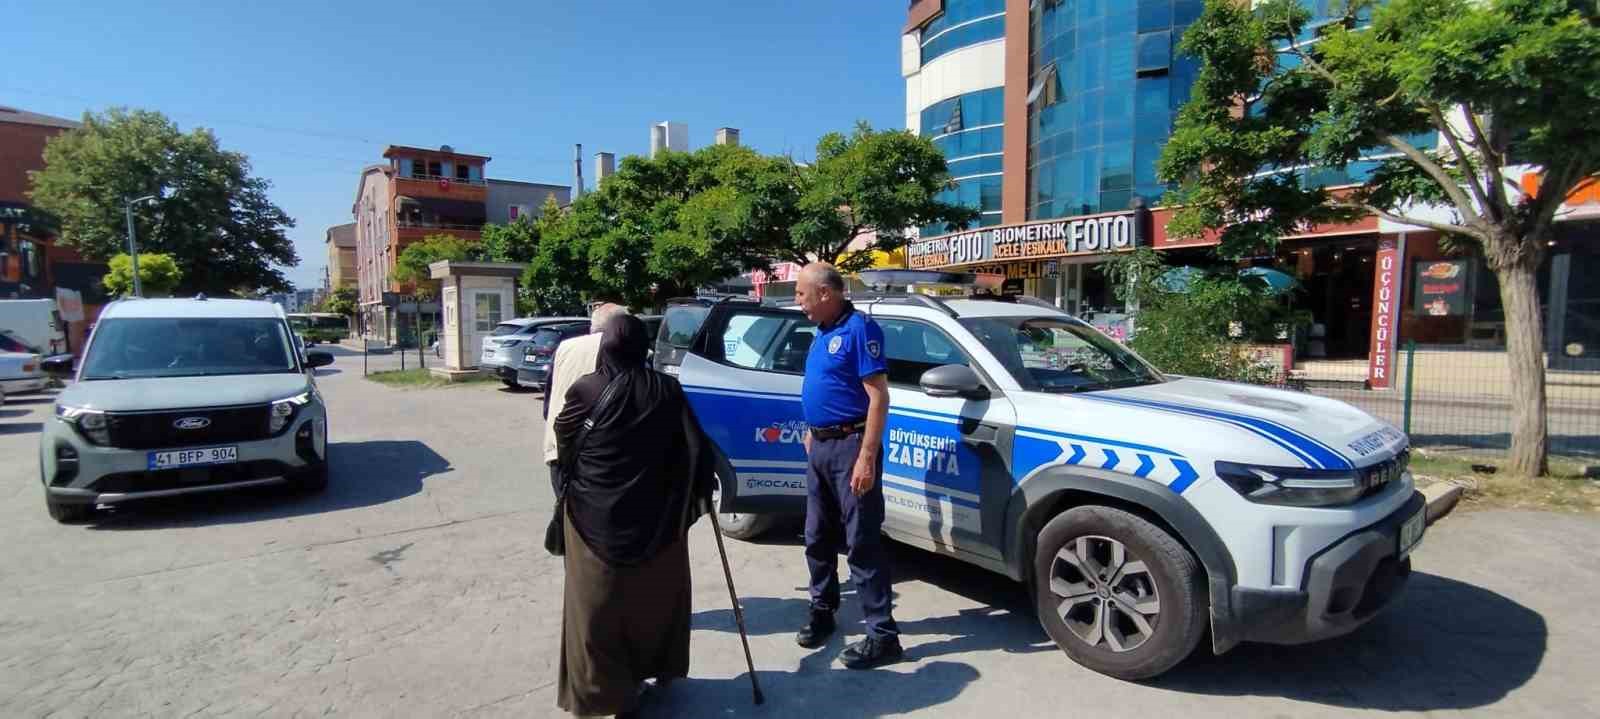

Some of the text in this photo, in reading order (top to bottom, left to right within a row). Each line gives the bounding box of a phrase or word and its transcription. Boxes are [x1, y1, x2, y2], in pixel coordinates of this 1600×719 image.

[1071, 215, 1129, 252] FOTO
[950, 231, 983, 264] FOTO
[992, 242, 1019, 259] ACELE
[1374, 255, 1393, 379] ÜÇÜNCÜLER
[755, 427, 807, 444] KOCA
[889, 428, 957, 452] BÜYÜKŞEHİR
[158, 448, 235, 465] 41 BFP 904
[888, 442, 960, 476] ZABITA
[757, 479, 807, 489] KOCAEL
